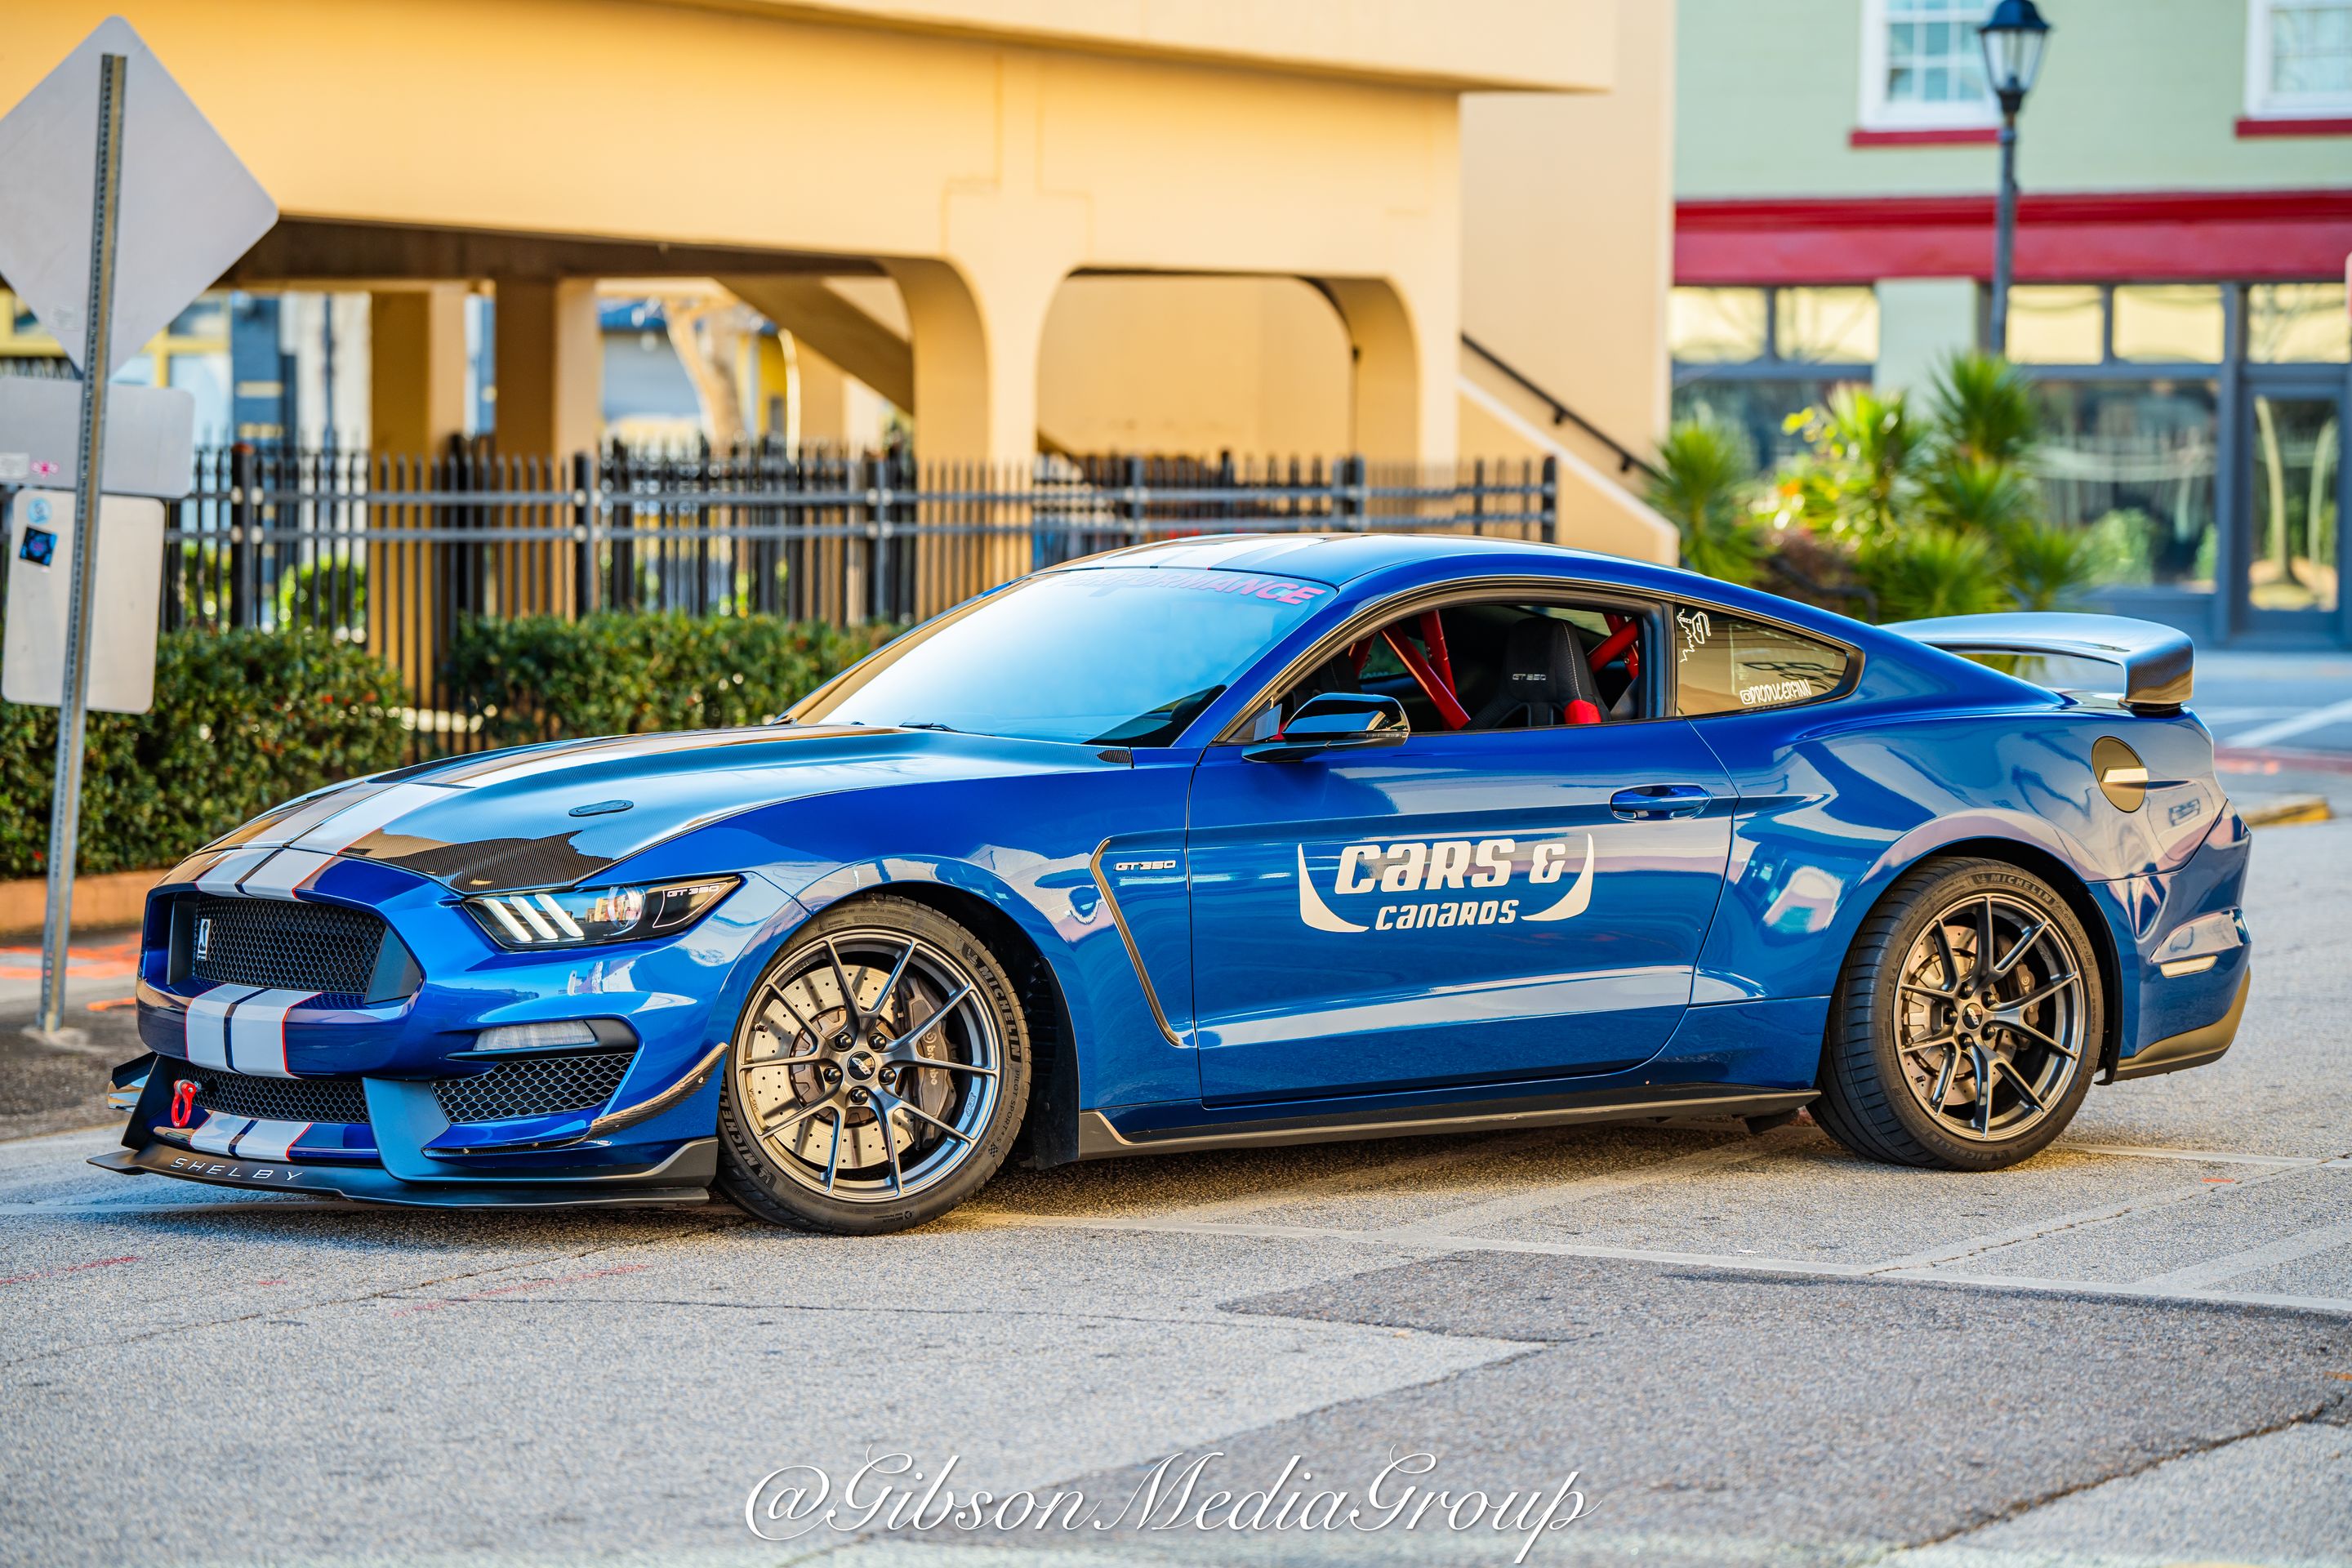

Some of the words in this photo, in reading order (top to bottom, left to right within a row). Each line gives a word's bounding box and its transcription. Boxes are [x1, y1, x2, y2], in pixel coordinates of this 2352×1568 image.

[1045, 571, 1326, 605] PERFORMANCE
[1113, 860, 1176, 871] GT350
[1334, 839, 1516, 894] CARS
[1528, 843, 1566, 884] &
[1990, 874, 2052, 902] MICHELIN
[978, 965, 1021, 1058] MICHELIN
[1003, 1099, 1016, 1133] SPORT
[170, 1157, 304, 1181] SHELBY
